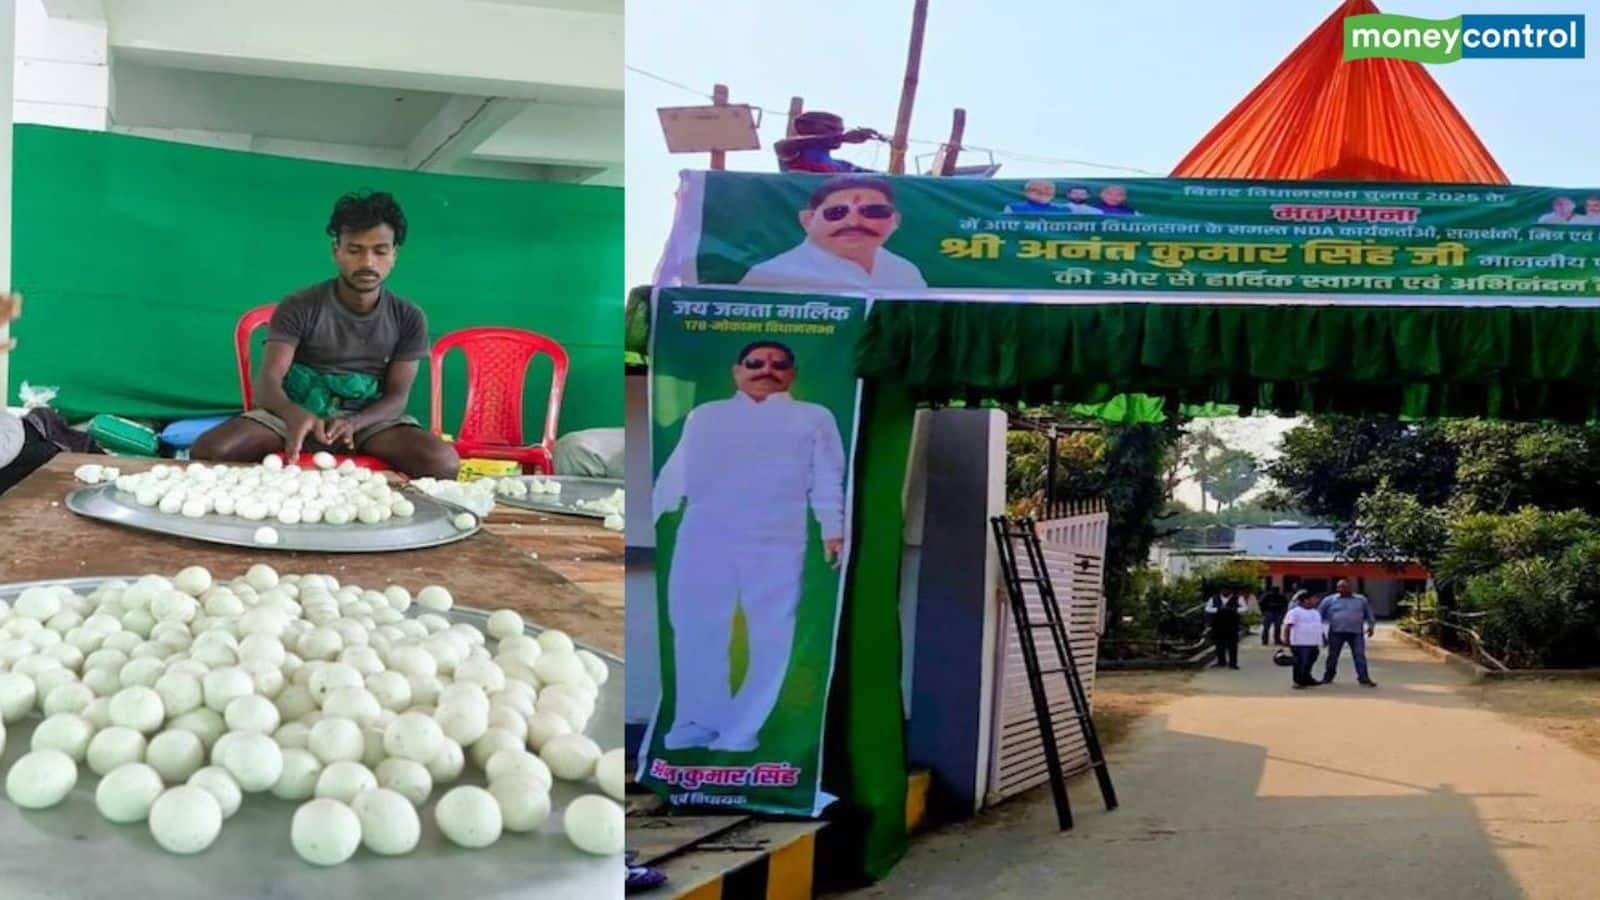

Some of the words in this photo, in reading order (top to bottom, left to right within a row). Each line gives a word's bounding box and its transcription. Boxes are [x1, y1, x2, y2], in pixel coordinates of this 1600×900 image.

[1184, 185, 1241, 197] बिहार
[1248, 186, 1357, 199] विधानसभा
[1364, 189, 1419, 202] चुनाव
[1426, 191, 1479, 202] 2025
[1270, 203, 1422, 224] मतगणना
[960, 216, 979, 231] में
[983, 219, 1022, 232] आए
[1025, 218, 1096, 233] मोकामा
[1101, 217, 1199, 235] विधानसभा
[1205, 221, 1222, 234] के
[1227, 223, 1288, 236] समस्त
[1293, 226, 1335, 236] NDA
[940, 233, 1006, 260] श्री
[1016, 236, 1141, 262] अनंत
[1148, 240, 1293, 269] कुमार
[1300, 237, 1399, 266] सिंह
[1404, 241, 1470, 267] जी
[1478, 253, 1586, 269] माननीय
[1054, 267, 1093, 286] की
[1104, 268, 1161, 287] ओर
[1168, 268, 1198, 287] से
[1204, 268, 1296, 289] हार्दिक
[1303, 274, 1395, 290] स्वागत
[1402, 273, 1443, 291] एवं
[1451, 274, 1586, 293] अभिनंदन
[671, 300, 708, 316] जय
[711, 301, 774, 319] जनता
[776, 301, 851, 321] मालिक
[680, 765, 750, 791] कुमार
[749, 761, 802, 787] सिंह
